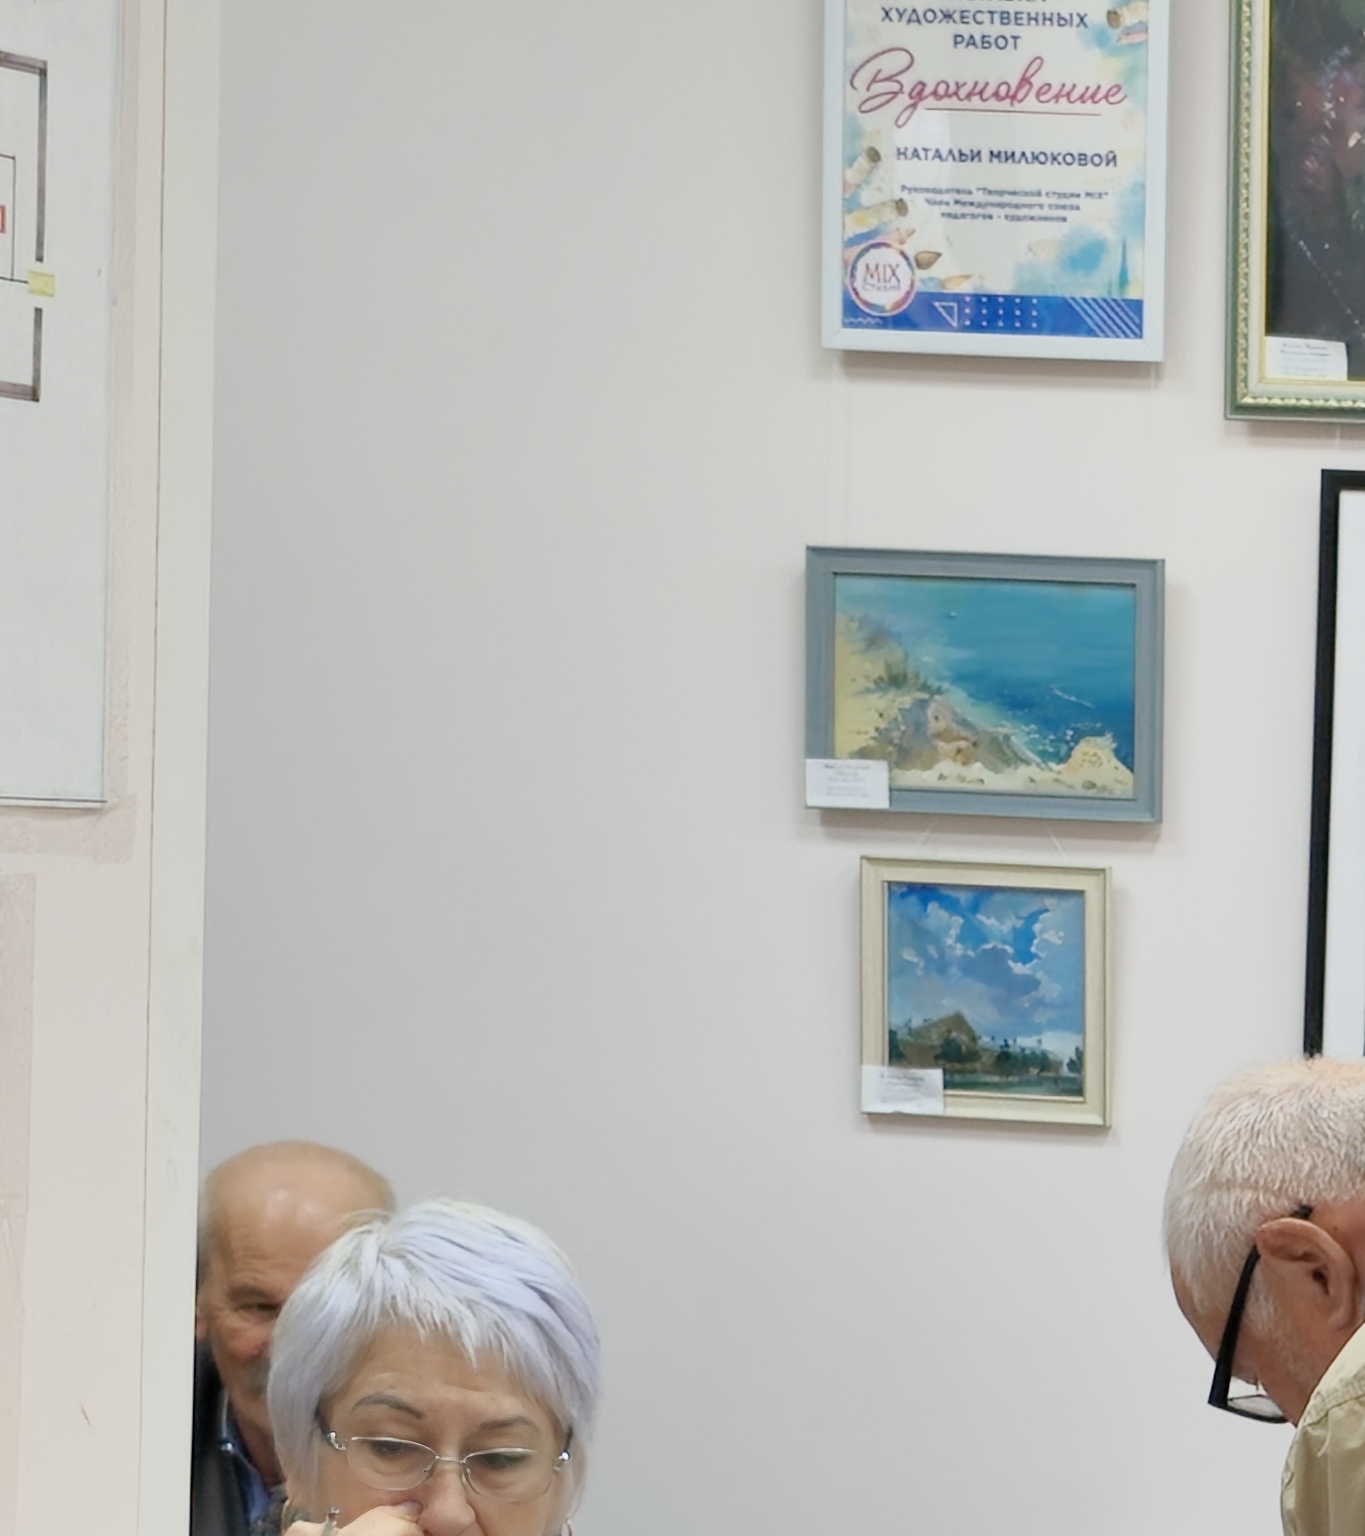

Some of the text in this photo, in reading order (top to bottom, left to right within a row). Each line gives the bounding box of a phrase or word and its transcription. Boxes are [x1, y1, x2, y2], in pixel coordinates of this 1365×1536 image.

[880, 7, 1089, 28] ХУДОЖЕСТВЕННЫХ
[952, 34, 1022, 50] РАБОТ
[850, 47, 1128, 128] Вдохновение
[896, 147, 1118, 167] НАТАЛЬИ МИЛЮКОВОЙ
[862, 263, 901, 283] MIX
